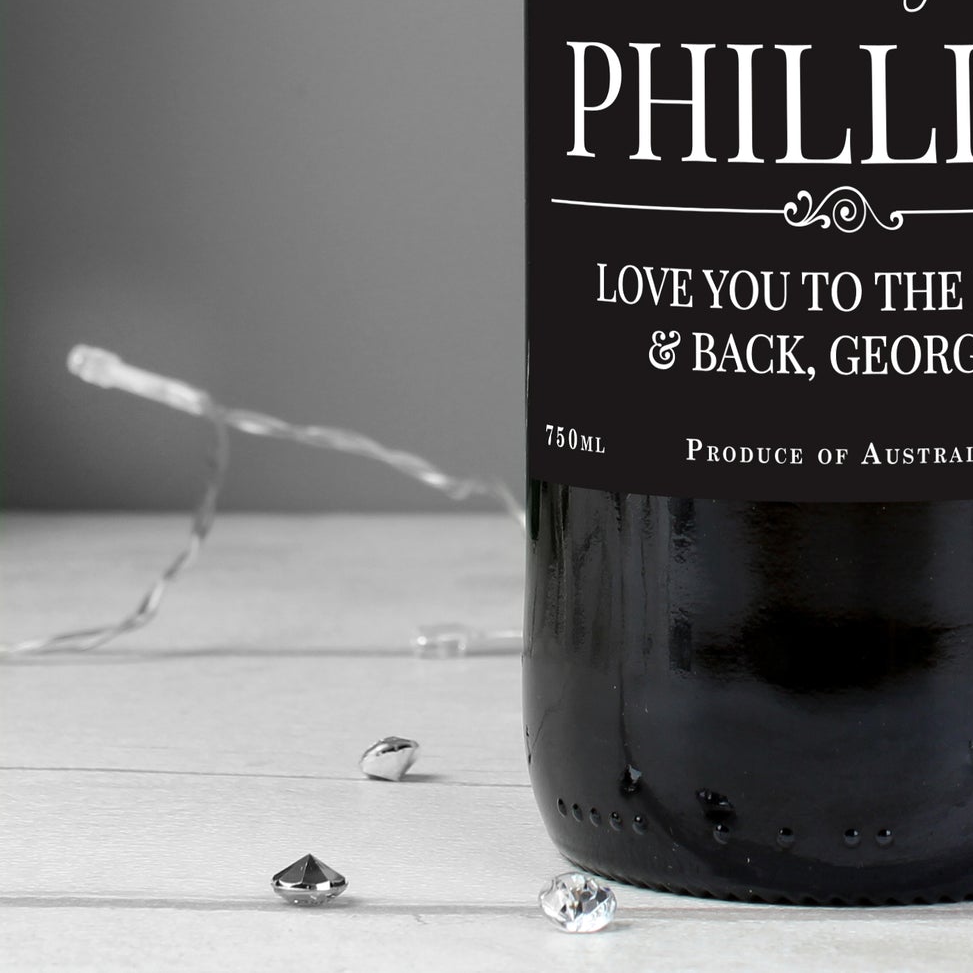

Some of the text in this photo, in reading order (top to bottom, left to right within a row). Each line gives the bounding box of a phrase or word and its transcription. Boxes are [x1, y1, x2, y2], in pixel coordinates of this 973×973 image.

[596, 262, 694, 308] LOVE
[701, 269, 791, 312] YOU
[801, 271, 863, 313] TO
[874, 270, 964, 312] THE
[648, 330, 682, 371] &
[691, 331, 816, 382] BACK,
